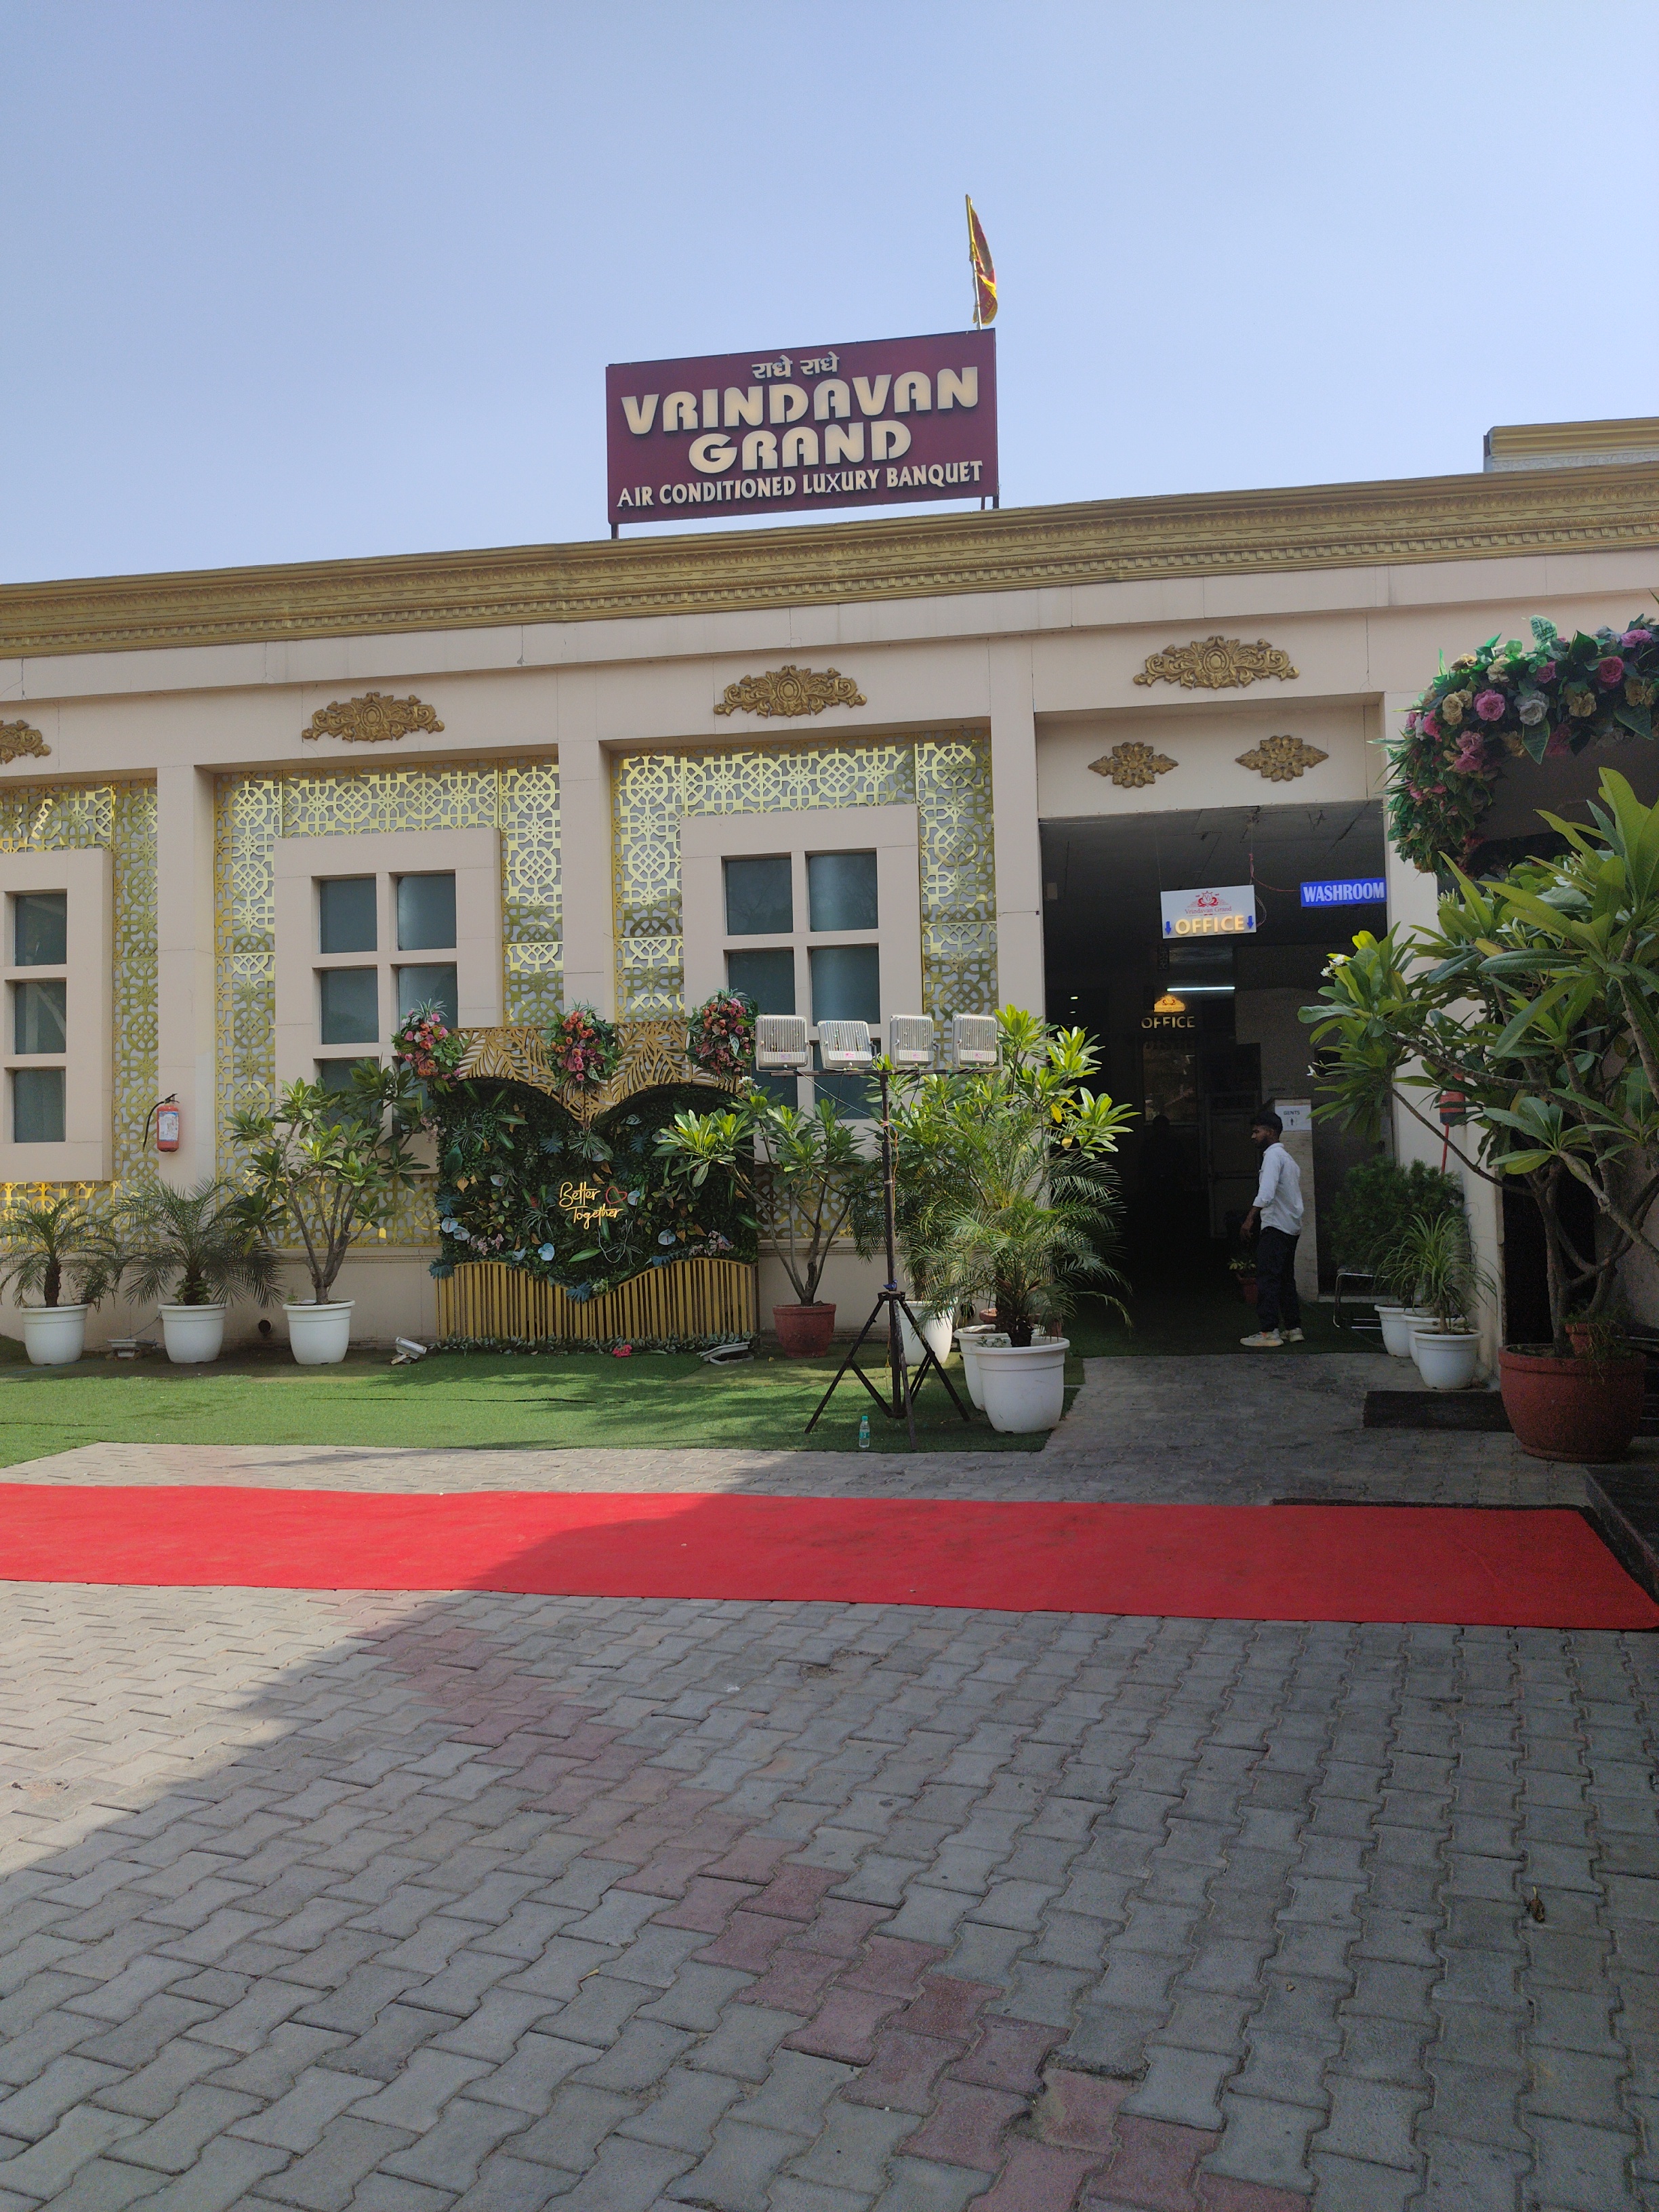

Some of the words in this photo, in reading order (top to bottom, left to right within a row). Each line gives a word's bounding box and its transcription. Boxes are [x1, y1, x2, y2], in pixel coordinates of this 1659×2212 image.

[752, 354, 793, 379] राधे
[800, 351, 840, 375] राधे
[621, 367, 979, 435] VRINDAVAN
[689, 419, 912, 474] GRAND
[617, 486, 654, 507] AIR
[659, 476, 796, 504] CONDITIONED
[803, 468, 880, 494] LUXURY
[886, 460, 983, 488] BANQUET
[1303, 882, 1385, 903] WASHROOM
[1175, 915, 1245, 935] OFFICE
[1141, 1016, 1195, 1029] OFFICE
[558, 1181, 601, 1208] Better
[565, 1203, 623, 1229] Together
